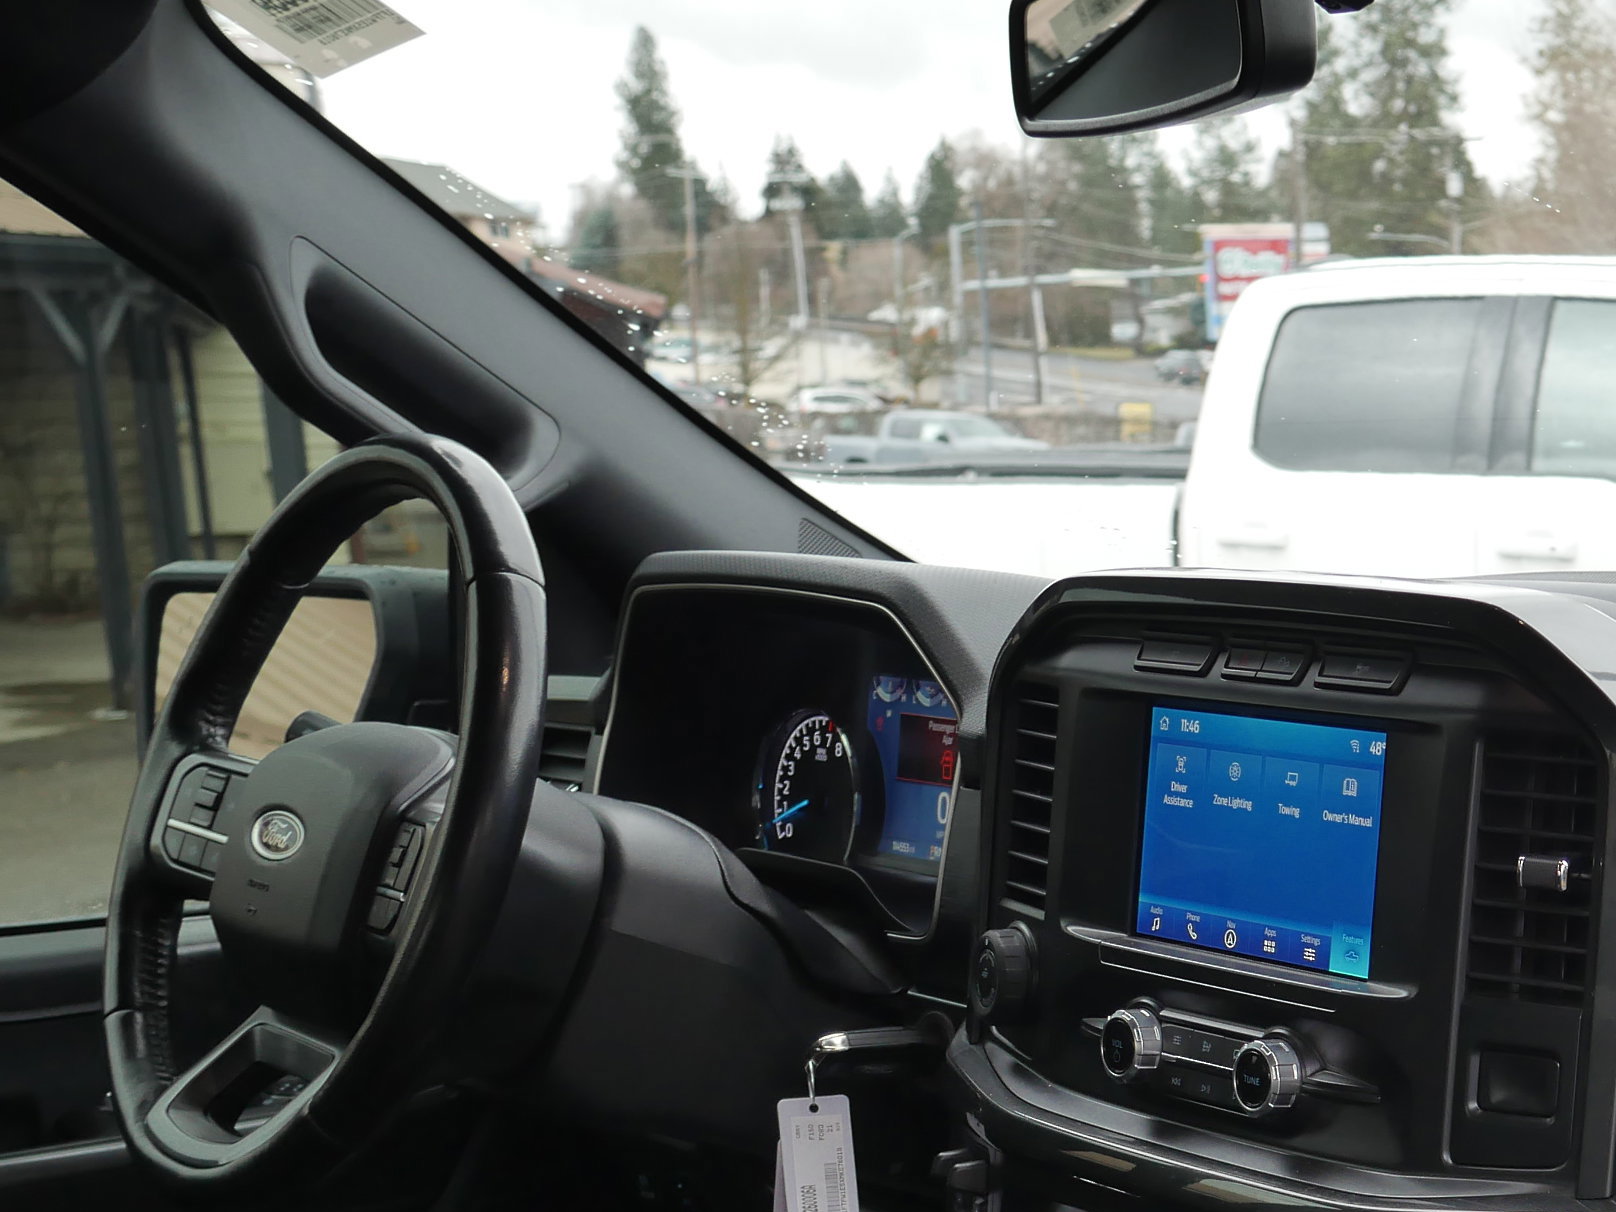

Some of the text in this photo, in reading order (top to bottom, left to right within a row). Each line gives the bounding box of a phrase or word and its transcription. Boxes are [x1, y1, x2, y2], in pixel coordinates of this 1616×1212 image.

[1181, 719, 1199, 733] 11:46
[803, 736, 810, 751] 5
[814, 731, 821, 745] 6
[826, 733, 833, 748] 7
[794, 746, 801, 760] 4
[835, 742, 842, 757] 8
[788, 761, 795, 775] 3
[783, 780, 790, 795] 2
[1171, 781, 1188, 793] Driver
[1163, 794, 1194, 808] Assistance
[1213, 793, 1252, 812] Zone Lighting
[1278, 803, 1300, 819] Towing
[1322, 810, 1373, 827] Owner's Manual
[786, 823, 793, 838] 0
[1186, 912, 1200, 922] Phone
[1264, 927, 1277, 938] Apps
[1301, 934, 1321, 947] Settings
[1342, 933, 1364, 945] Features
[1243, 1074, 1261, 1086] TUNE
